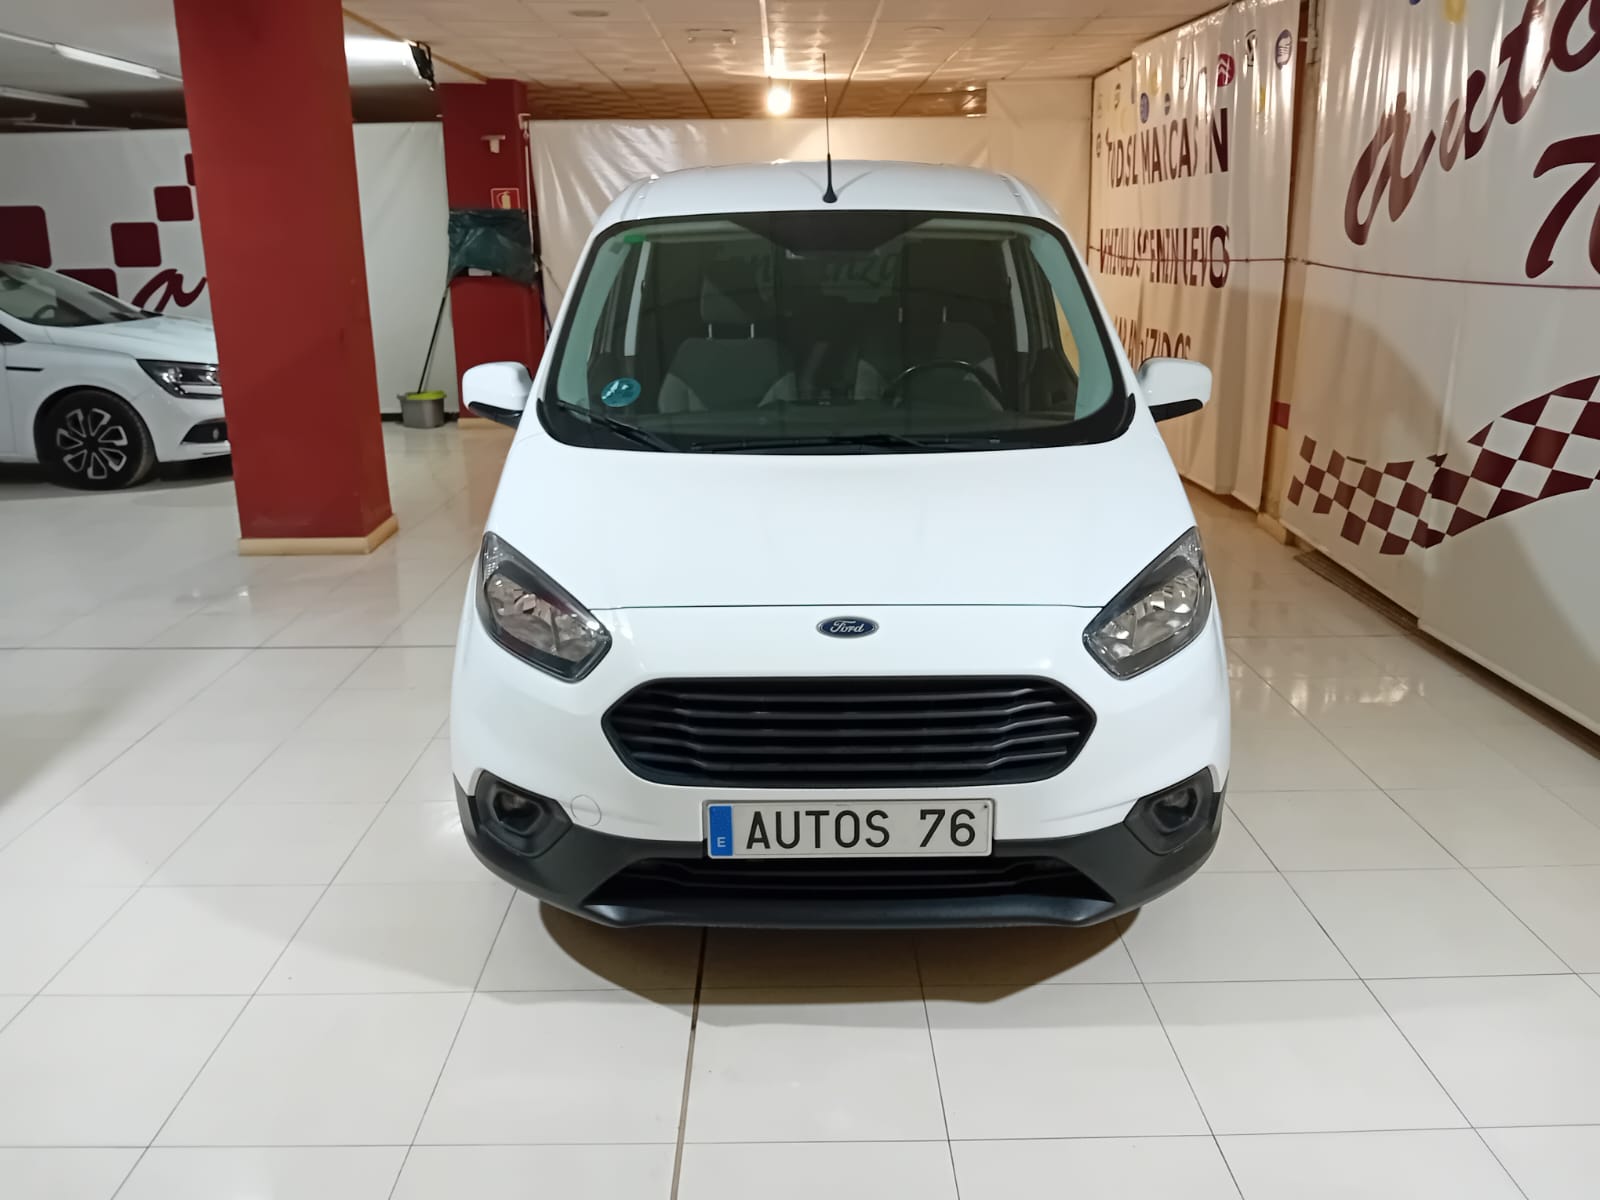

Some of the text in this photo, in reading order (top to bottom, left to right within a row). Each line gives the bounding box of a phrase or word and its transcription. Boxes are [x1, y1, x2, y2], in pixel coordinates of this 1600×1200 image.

[829, 619, 865, 634] Ford
[746, 808, 976, 850] AUTOS 76
[716, 836, 727, 848] E
